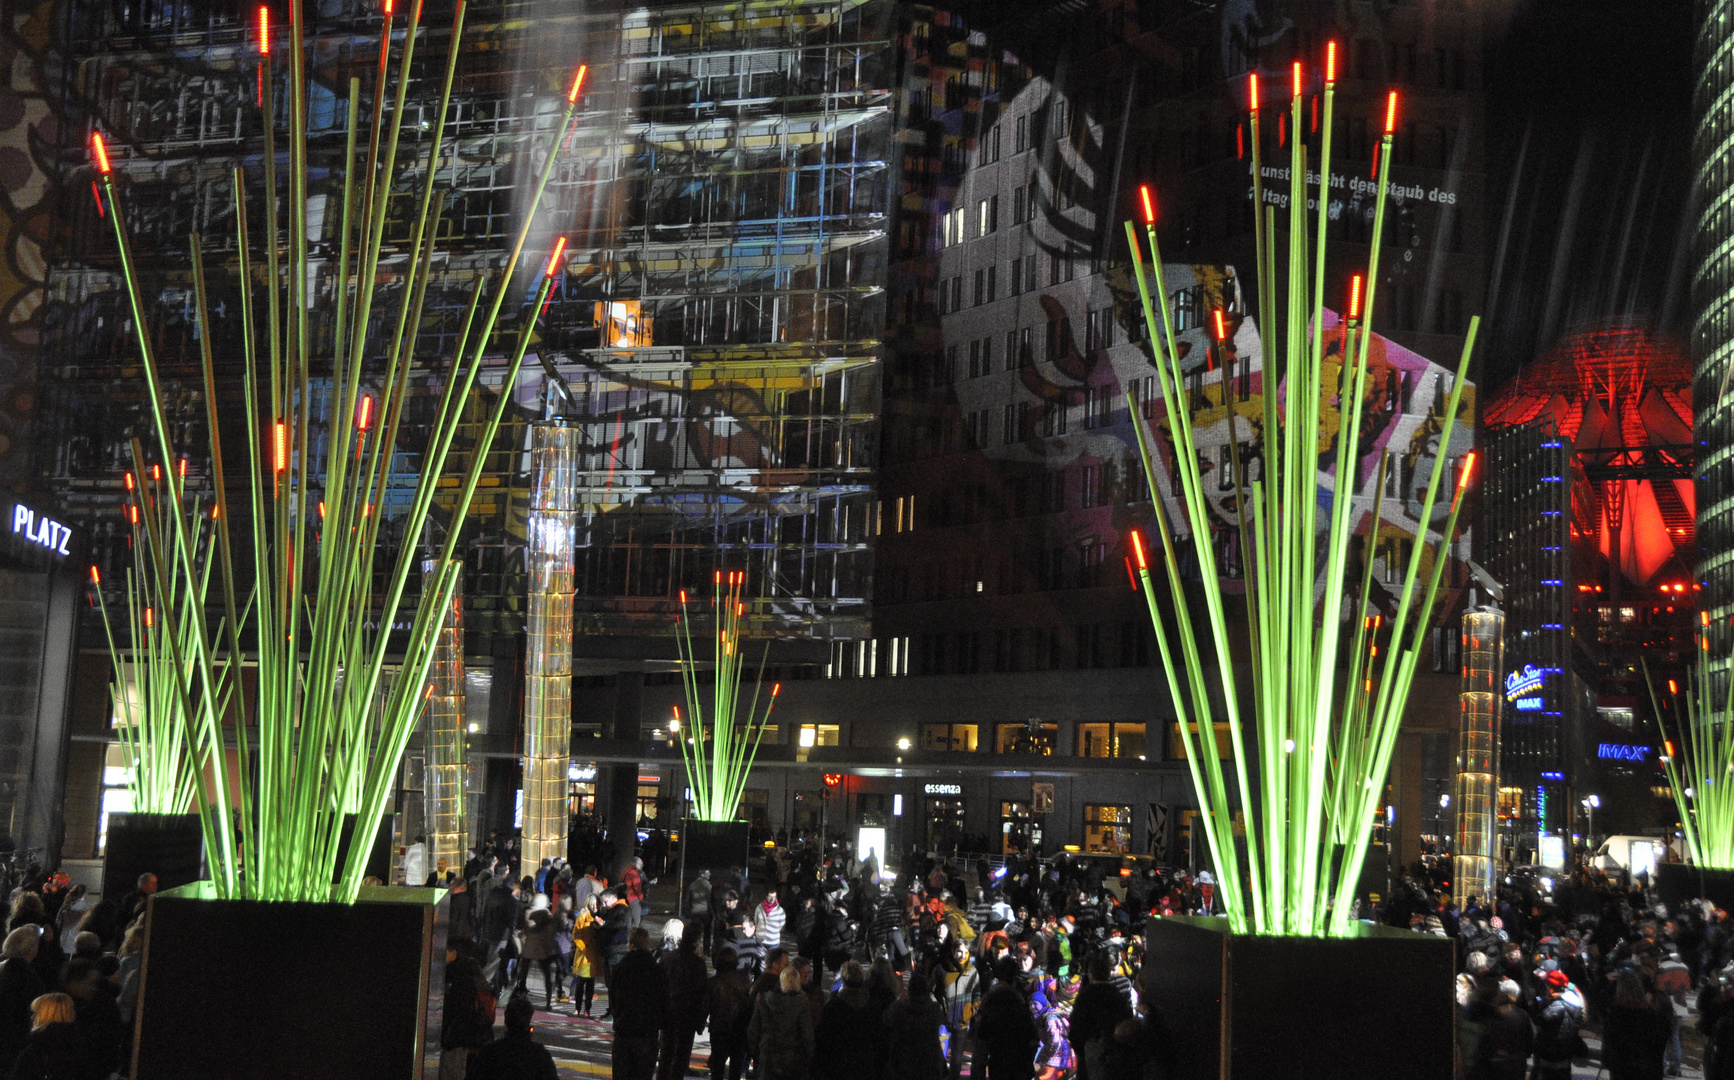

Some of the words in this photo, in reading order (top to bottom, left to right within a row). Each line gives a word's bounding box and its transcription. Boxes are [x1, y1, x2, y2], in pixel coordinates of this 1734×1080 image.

[1304, 170, 1345, 188] äsht
[1349, 176, 1378, 194] den
[1428, 187, 1456, 204] des
[13, 503, 73, 556] PLATZ
[1516, 697, 1542, 710] IMAX
[1598, 743, 1646, 761] IMAX
[924, 783, 962, 795] essenza
